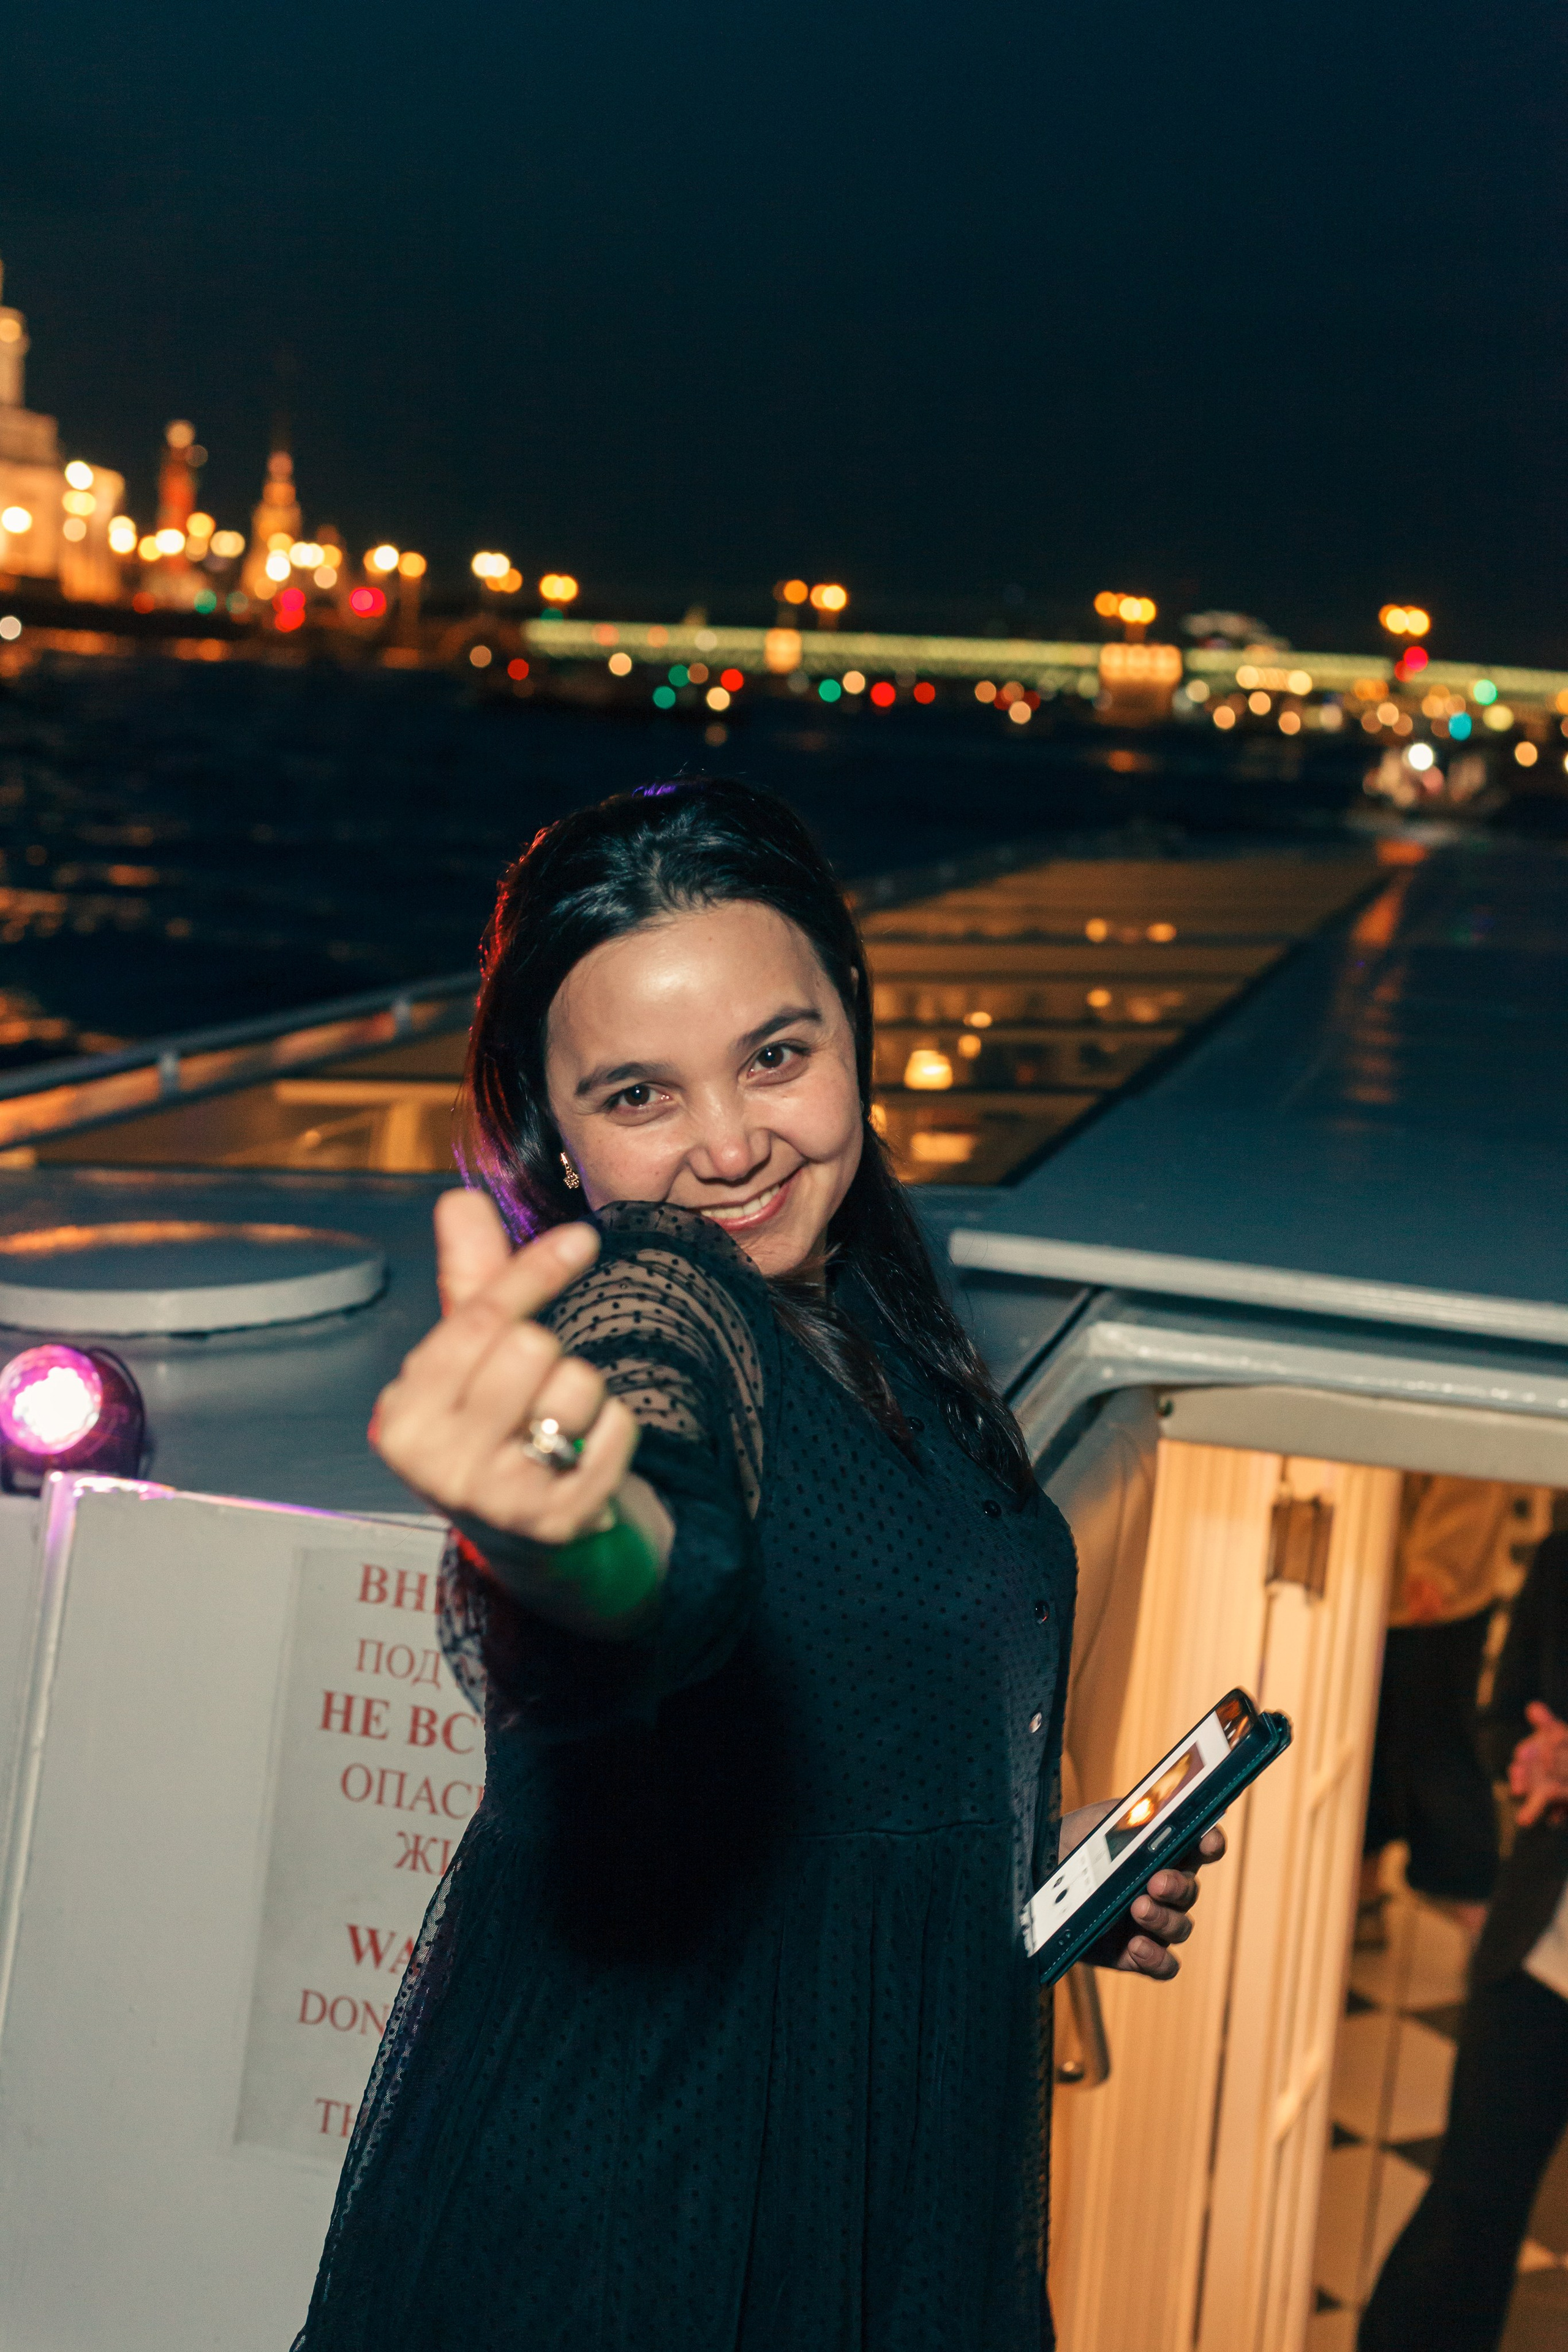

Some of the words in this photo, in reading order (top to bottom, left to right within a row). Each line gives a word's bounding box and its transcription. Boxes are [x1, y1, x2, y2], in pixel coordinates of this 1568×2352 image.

[355, 1638, 442, 1689] ПОД
[319, 1690, 391, 1741] НЕ
[407, 1705, 486, 1755] ВС
